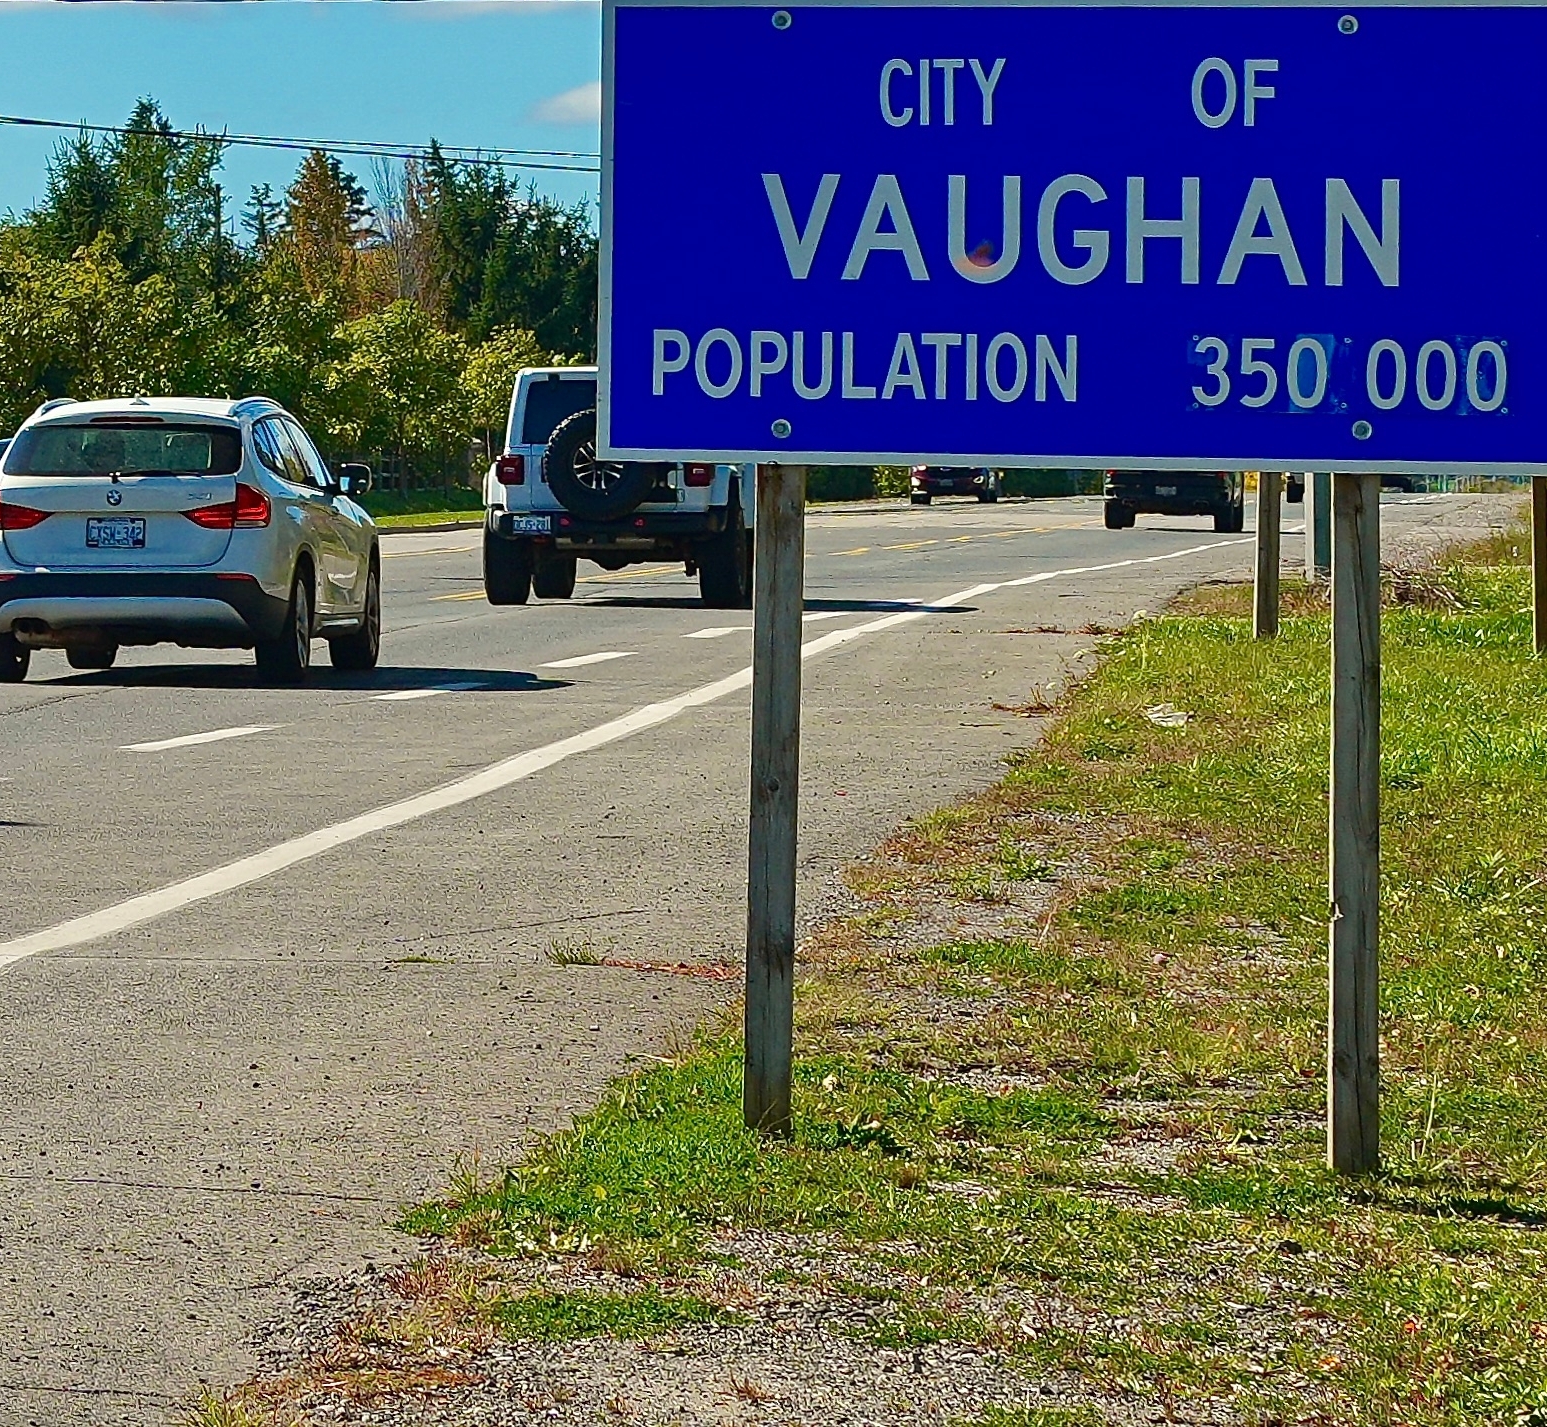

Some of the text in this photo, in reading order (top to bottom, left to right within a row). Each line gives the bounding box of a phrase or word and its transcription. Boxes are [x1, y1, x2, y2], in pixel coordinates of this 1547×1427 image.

[880, 57, 1279, 128] CITY OF
[762, 173, 1400, 287] VAUGHAN
[652, 328, 1078, 403] POPULATION
